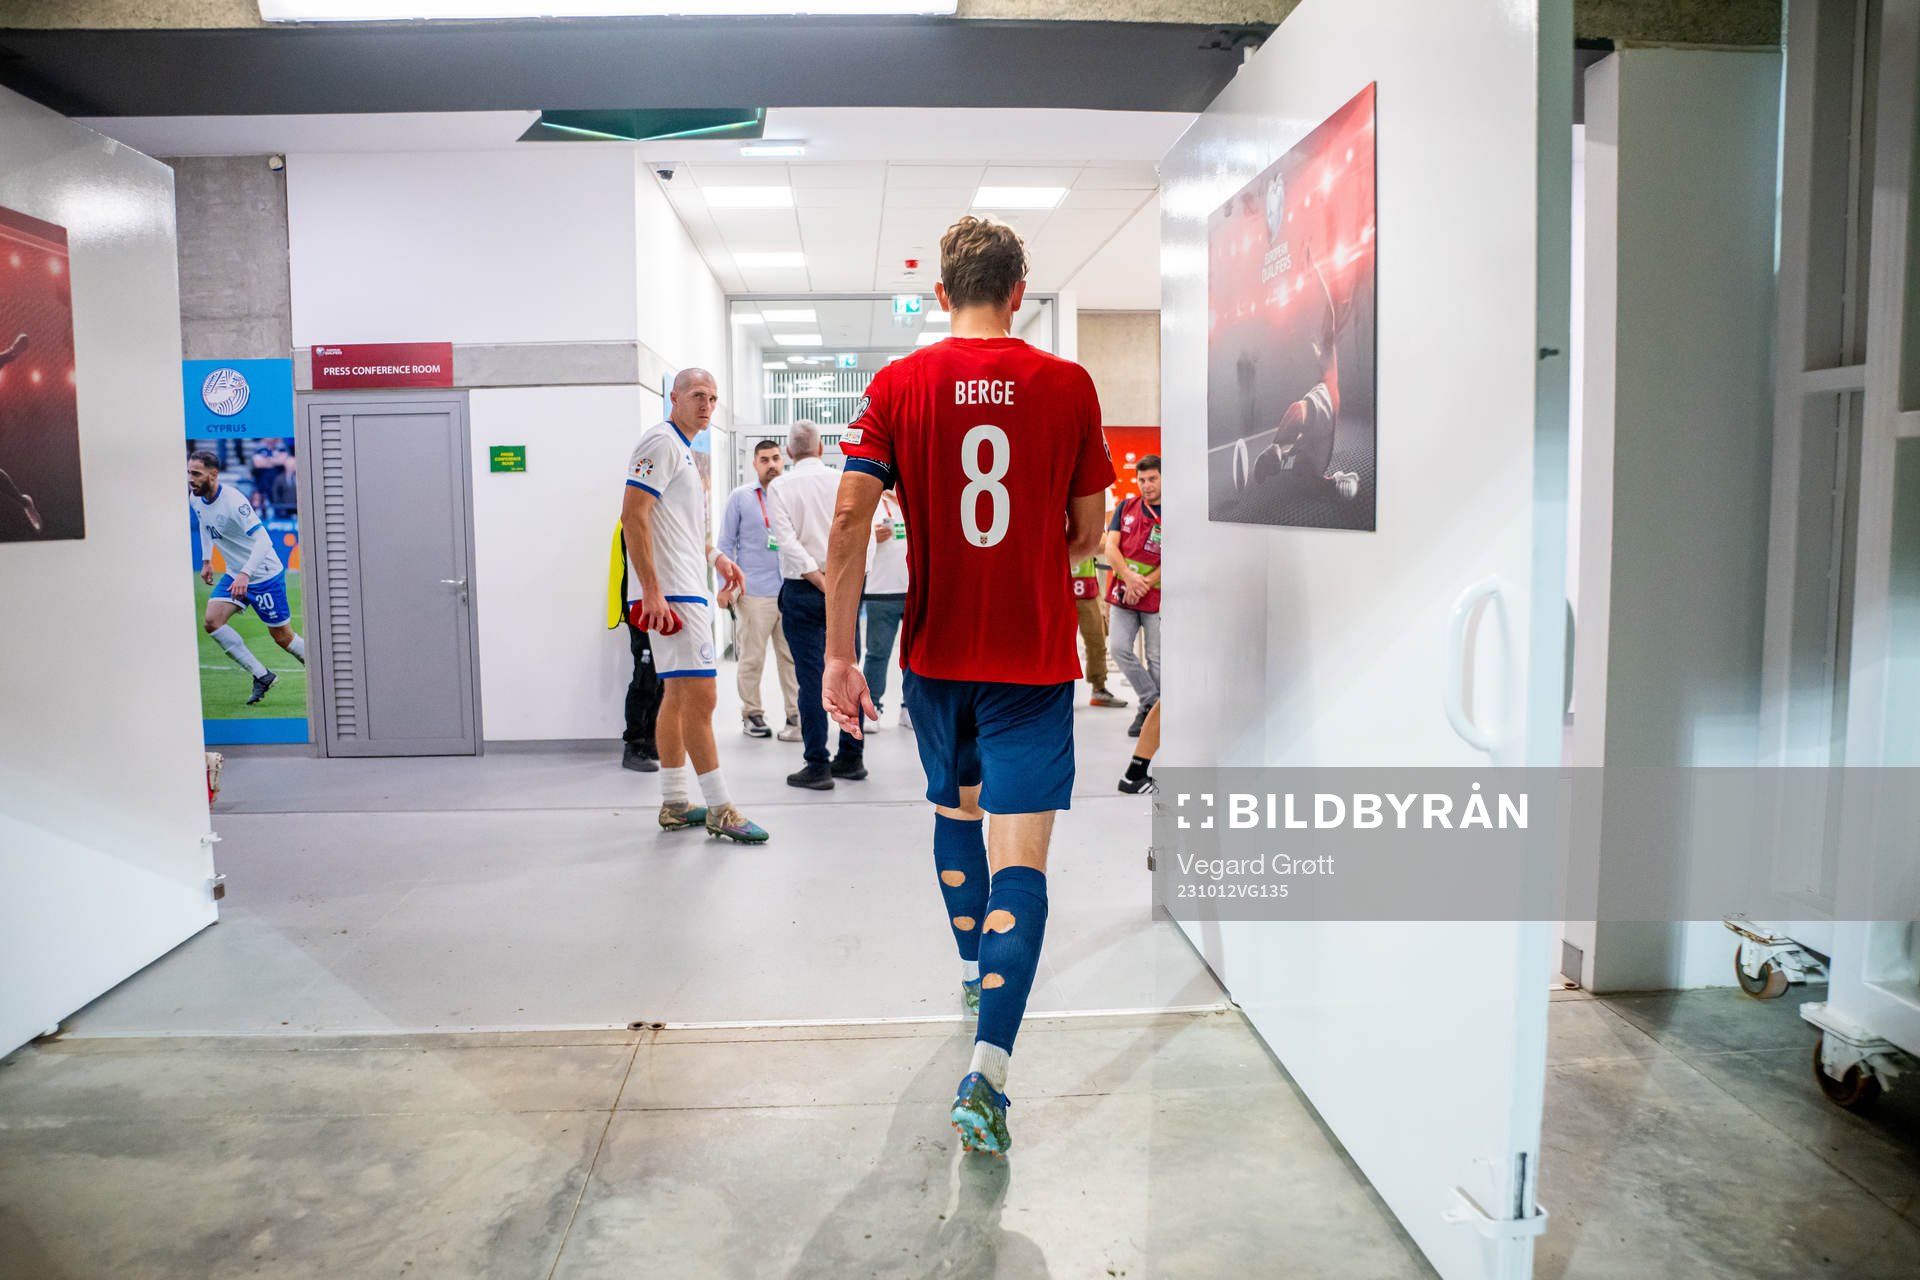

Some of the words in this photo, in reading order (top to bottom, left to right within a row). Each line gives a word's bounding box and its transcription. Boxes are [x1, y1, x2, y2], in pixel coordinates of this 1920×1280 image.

[1262, 254, 1291, 284] QUALIFIERS
[323, 366, 351, 376] PRESS
[352, 365, 411, 375] CONFERENCE
[412, 364, 441, 374] ROOM
[955, 379, 1015, 405] BERGE
[206, 424, 247, 433] CYPRUS
[961, 424, 1010, 547] 8
[1073, 580, 1085, 596] 8
[256, 592, 275, 610] 20
